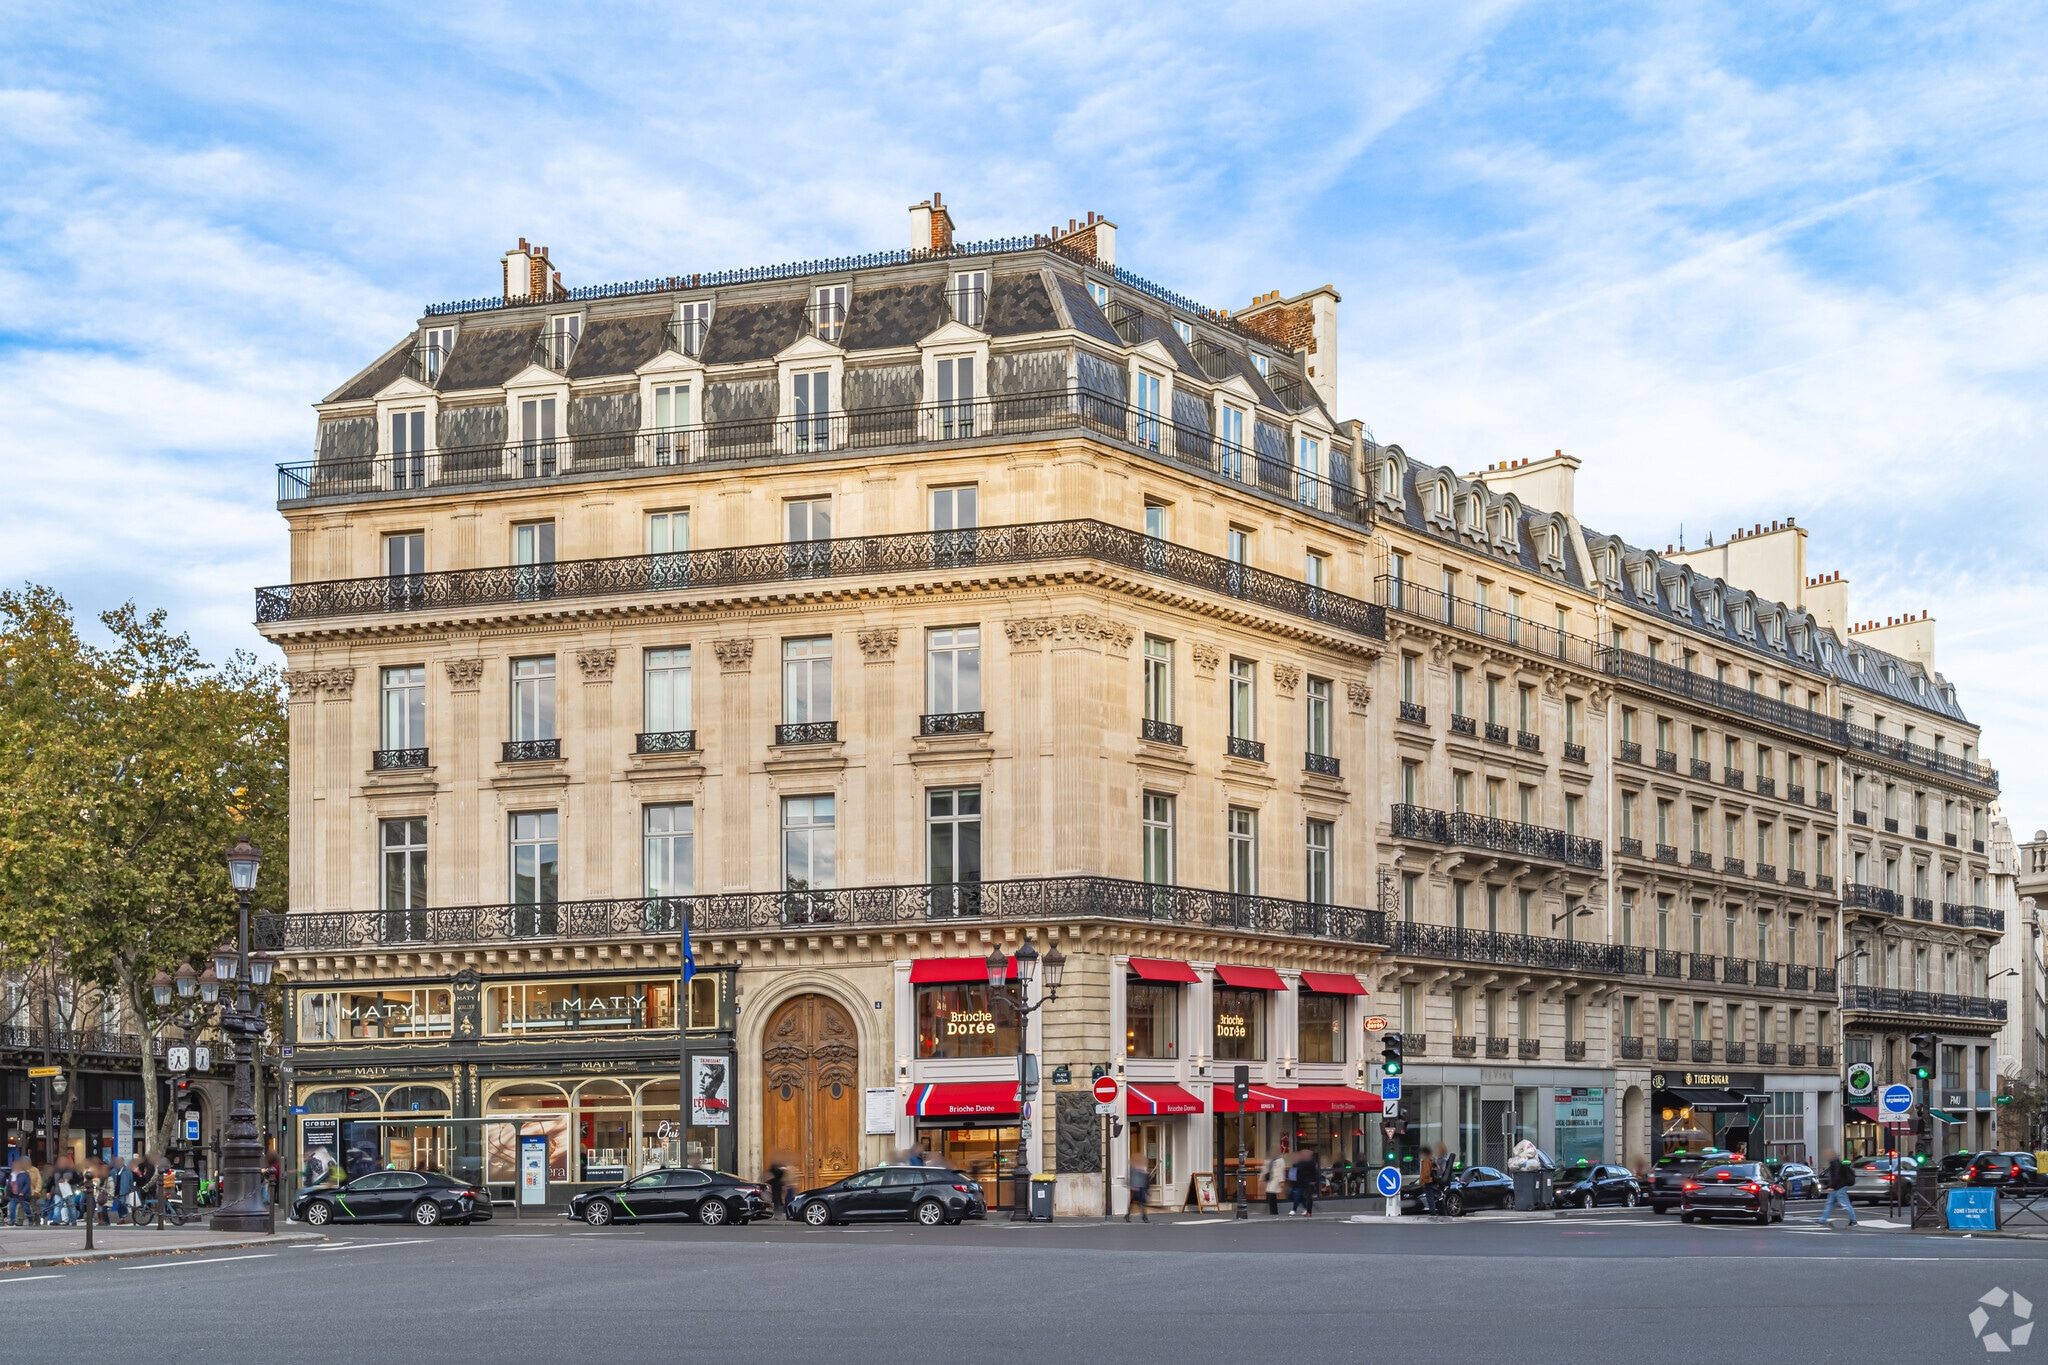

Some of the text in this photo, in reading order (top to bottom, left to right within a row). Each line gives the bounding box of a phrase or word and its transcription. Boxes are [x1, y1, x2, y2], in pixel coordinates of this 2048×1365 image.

[563, 996, 646, 1011] MATY
[341, 1004, 414, 1020] MATY
[951, 1011, 992, 1022] Brioche
[947, 1022, 996, 1035] Dorée
[1217, 1024, 1246, 1037] Dorée
[355, 1067, 388, 1075] MATY
[1694, 1074, 1729, 1085] TIGER SUGAR
[1950, 1095, 1961, 1105] PMU
[949, 1104, 995, 1113] Brioche Dorée
[1575, 1108, 1588, 1117] LOUER
